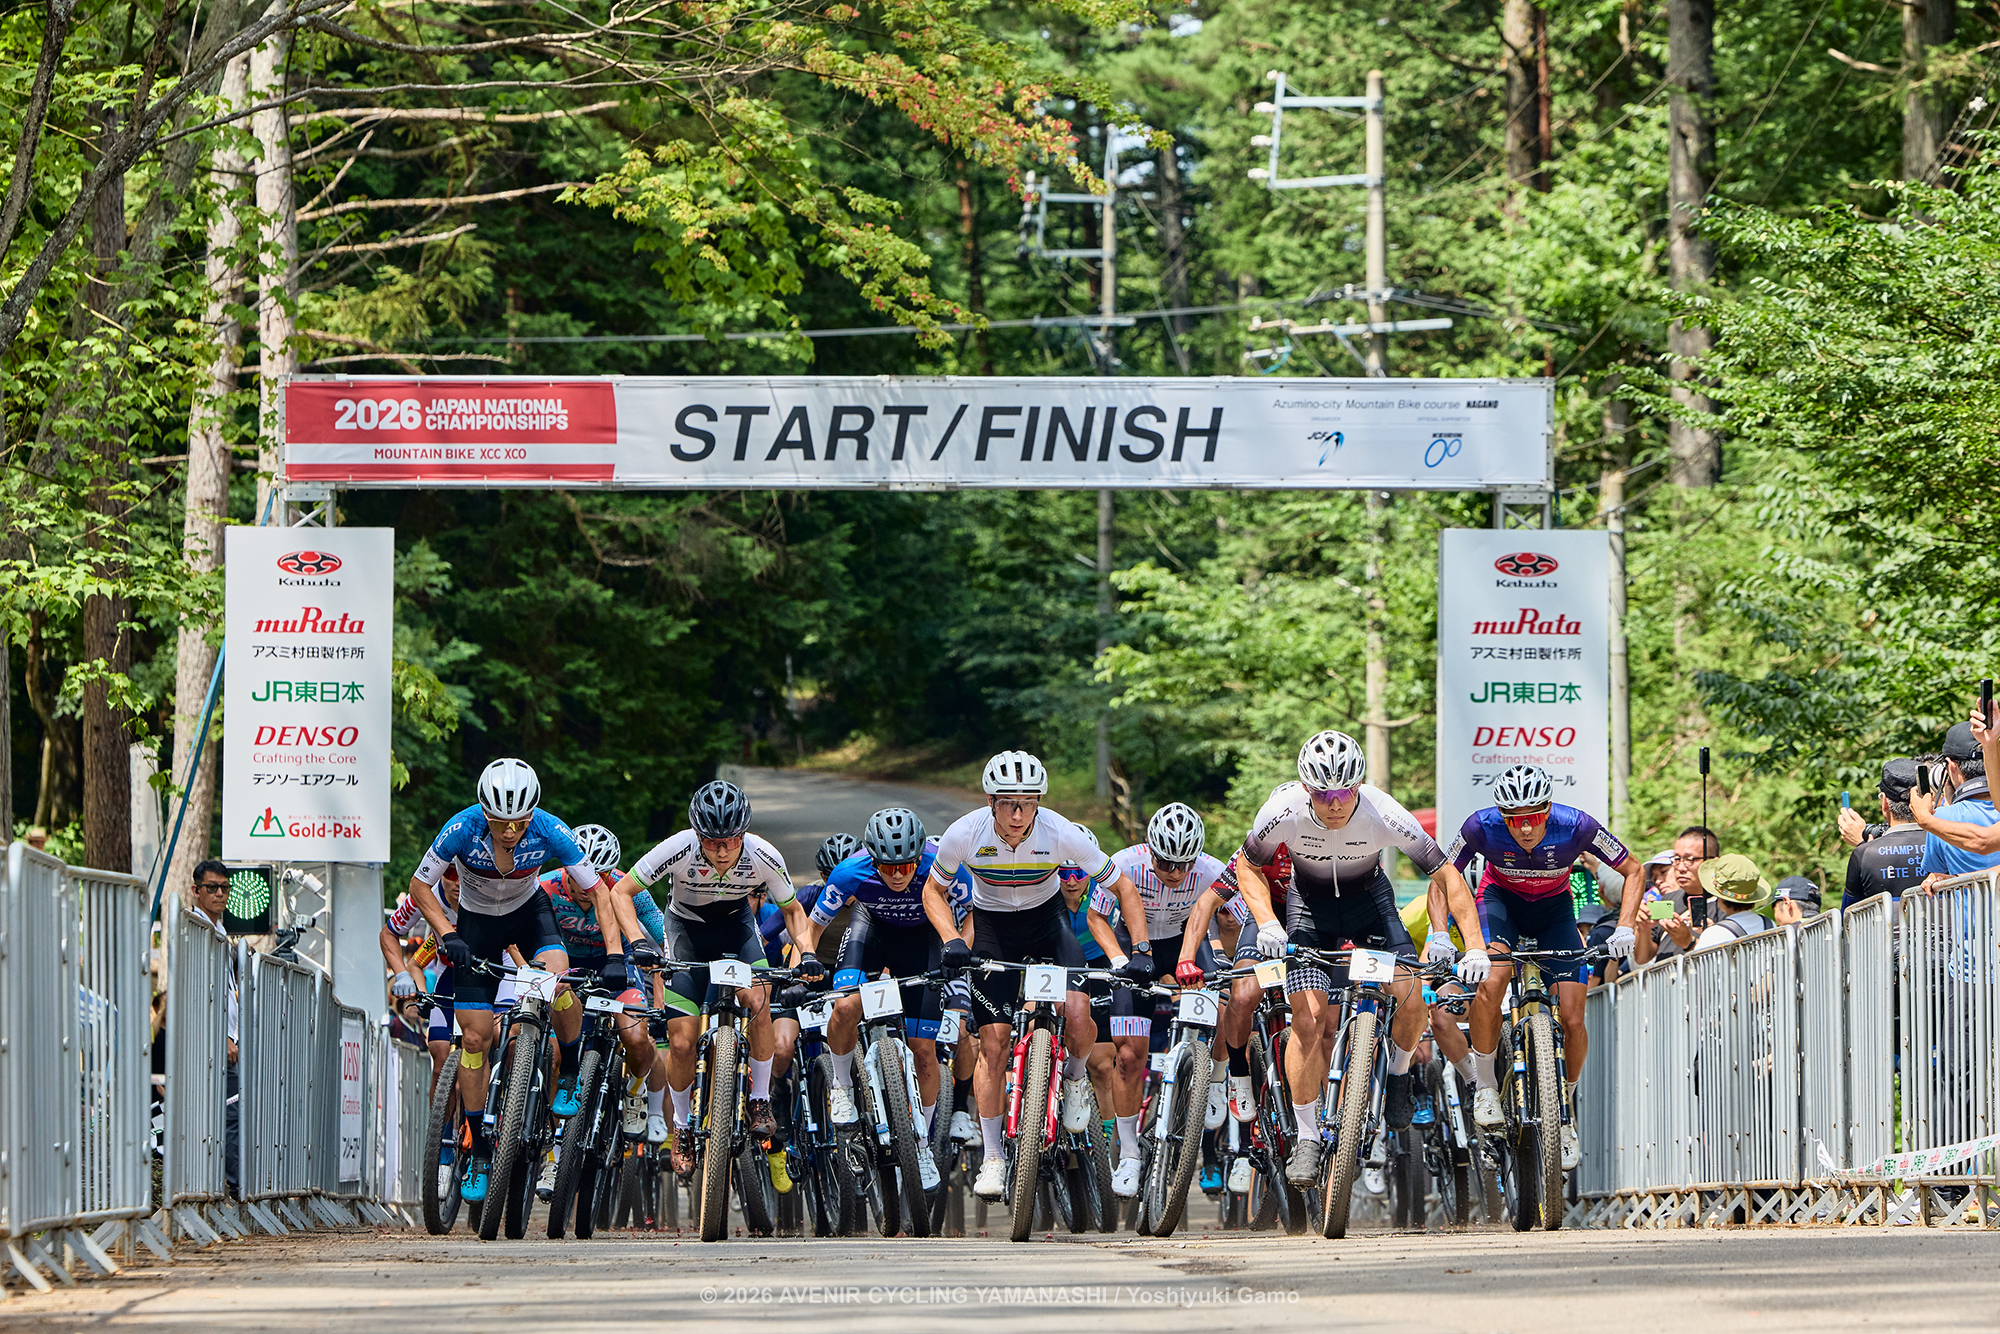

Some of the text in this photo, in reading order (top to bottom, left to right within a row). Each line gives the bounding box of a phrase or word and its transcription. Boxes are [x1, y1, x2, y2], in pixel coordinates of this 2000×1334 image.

[425, 399, 569, 414] JAPAN NATIONAL
[1272, 399, 1498, 411] Azumino-city Mountain Bike course NAGANO
[335, 398, 422, 430] 2026
[425, 414, 569, 430] CHAMPIONSHIPS
[1307, 431, 1329, 440] JCF
[374, 448, 527, 460] MOUNTAIN BIKE XCC XCO
[278, 577, 341, 587] Kabuto
[1496, 579, 1558, 588] Kabuto
[253, 606, 365, 634] muRata
[1471, 608, 1582, 635] muRata
[252, 645, 365, 659] アズミ村田製作所
[1470, 647, 1582, 660] アズミ村田製作所
[251, 681, 364, 703] JR東日本
[1470, 682, 1582, 704] JR東日本
[254, 726, 359, 747] DENSO
[1472, 727, 1576, 747] DENSO
[253, 753, 357, 766] Crafting the Core
[1471, 753, 1575, 765] Crafting the Core
[253, 773, 359, 786] デンソーエアクール
[288, 822, 362, 839] Gold-Pak
[435, 822, 462, 852] NESTO
[1878, 845, 1926, 856] CHAMPIG
[466, 858, 494, 868] FACTO
[650, 843, 692, 882] MERIDA
[756, 847, 782, 870] MERIDA
[1907, 856, 1921, 866] et
[1880, 865, 1928, 879] TÊTE RA
[680, 880, 759, 890] MERIDA
[724, 965, 737, 980] 4
[1270, 966, 1282, 980] 1
[1365, 957, 1379, 974] 3
[530, 977, 541, 992] 6
[1040, 973, 1052, 993] 2
[874, 989, 885, 1009] 7
[1193, 996, 1204, 1016] 8
